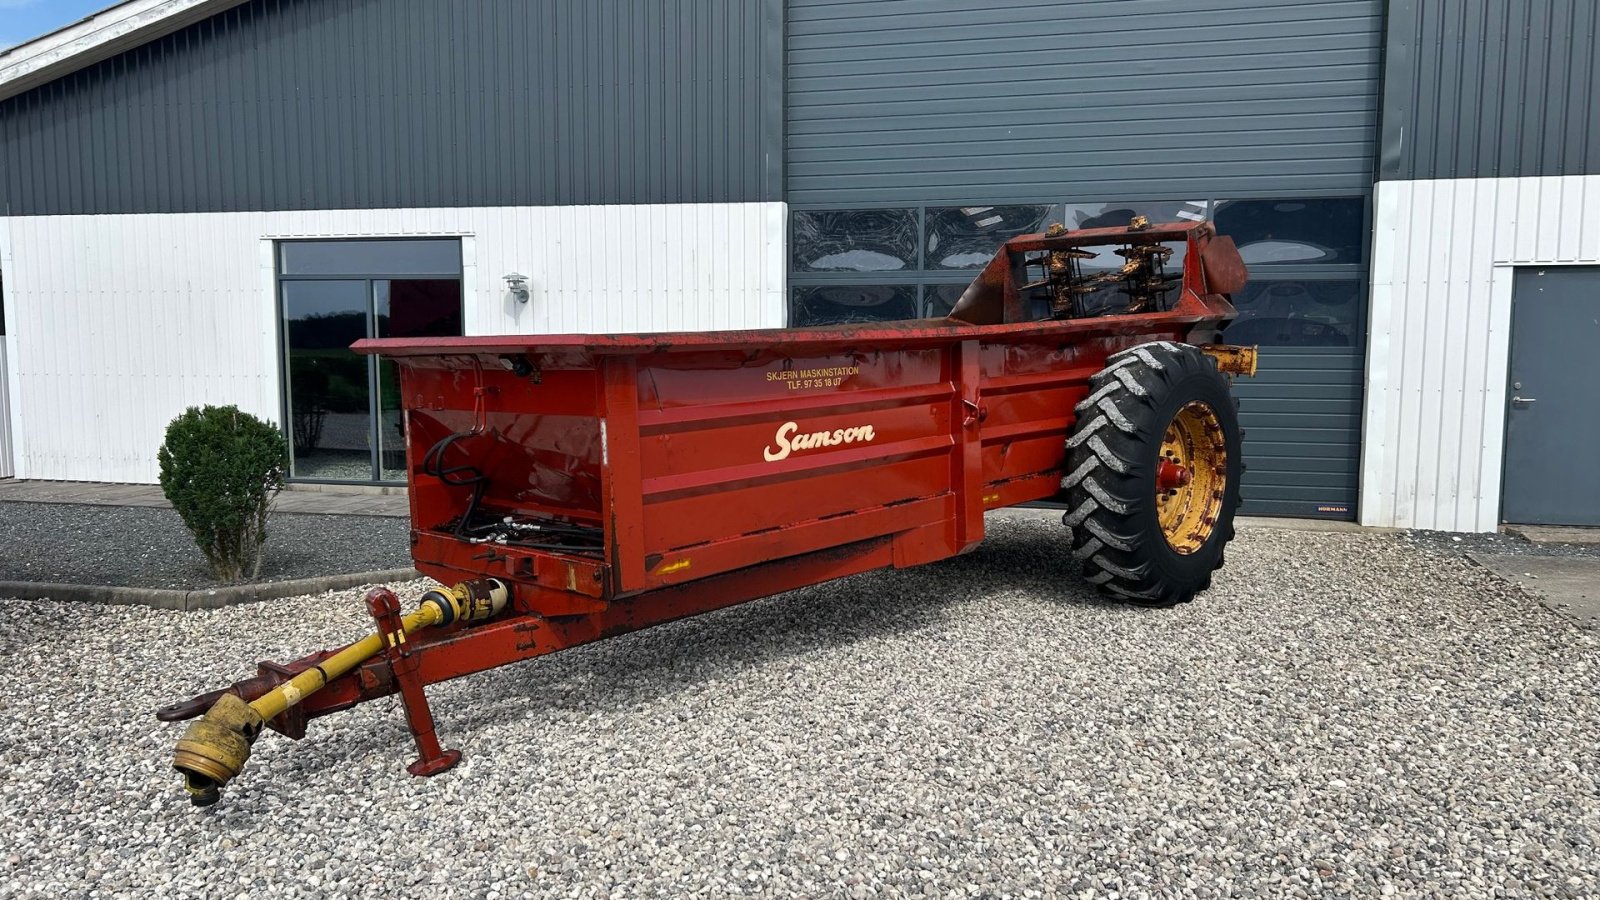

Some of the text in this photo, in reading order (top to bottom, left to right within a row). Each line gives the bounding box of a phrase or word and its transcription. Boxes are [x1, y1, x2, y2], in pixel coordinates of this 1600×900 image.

[766, 366, 859, 381] SKJERN MASKINSTATION
[787, 381, 803, 390] TLF.
[804, 380, 813, 388] 97
[814, 379, 823, 388] 35
[825, 378, 832, 387] 18
[763, 421, 875, 462] Samson
